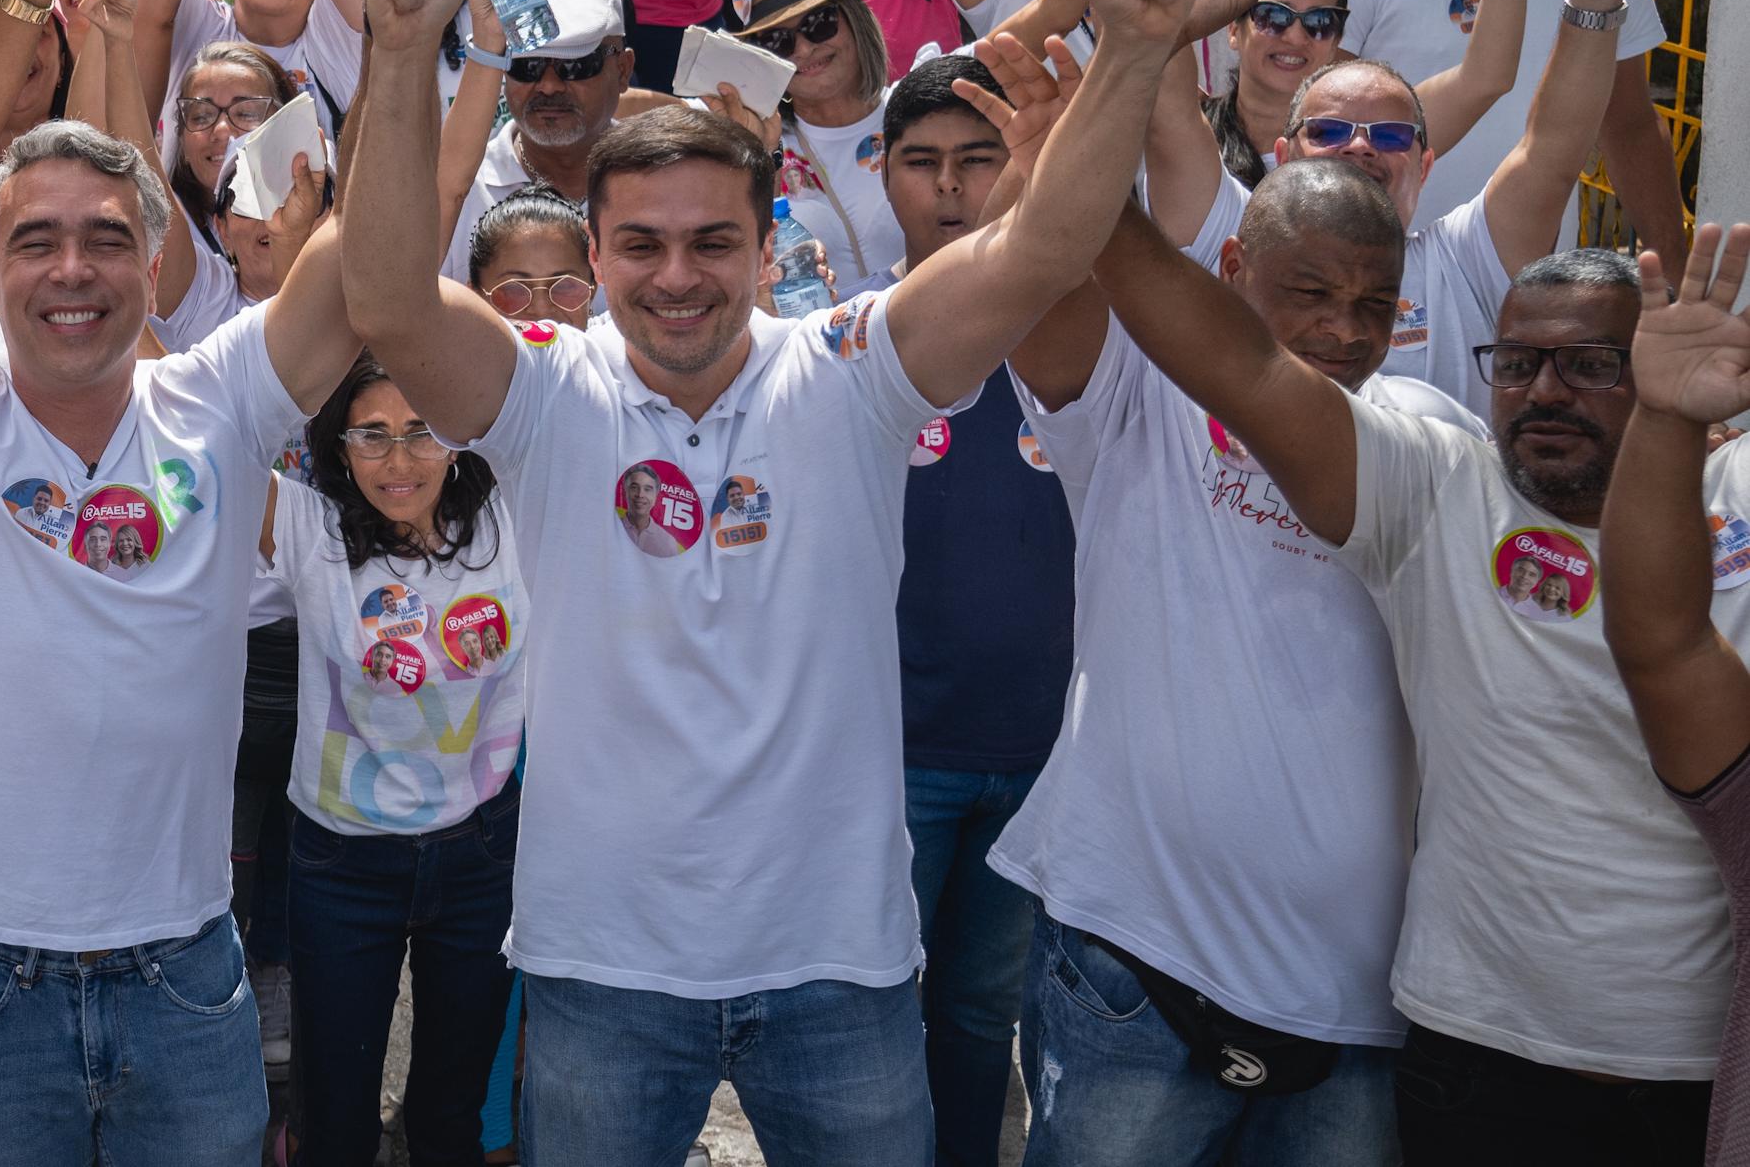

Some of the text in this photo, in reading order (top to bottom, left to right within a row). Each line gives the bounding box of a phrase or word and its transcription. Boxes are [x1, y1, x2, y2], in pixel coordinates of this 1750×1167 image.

[920, 427, 945, 447] 15
[660, 483, 698, 502] RAFAEL
[126, 502, 147, 519] 15
[661, 497, 695, 532] 15
[746, 512, 772, 523] Pierre
[40, 524, 68, 540] Pierre
[721, 525, 763, 545] 15151
[1272, 539, 1330, 563] DOUBT ME
[1564, 555, 1588, 577] 15
[481, 604, 498, 621] 15
[382, 622, 418, 639] 15151
[395, 653, 422, 666] RAFAEL
[395, 662, 418, 685] 15
